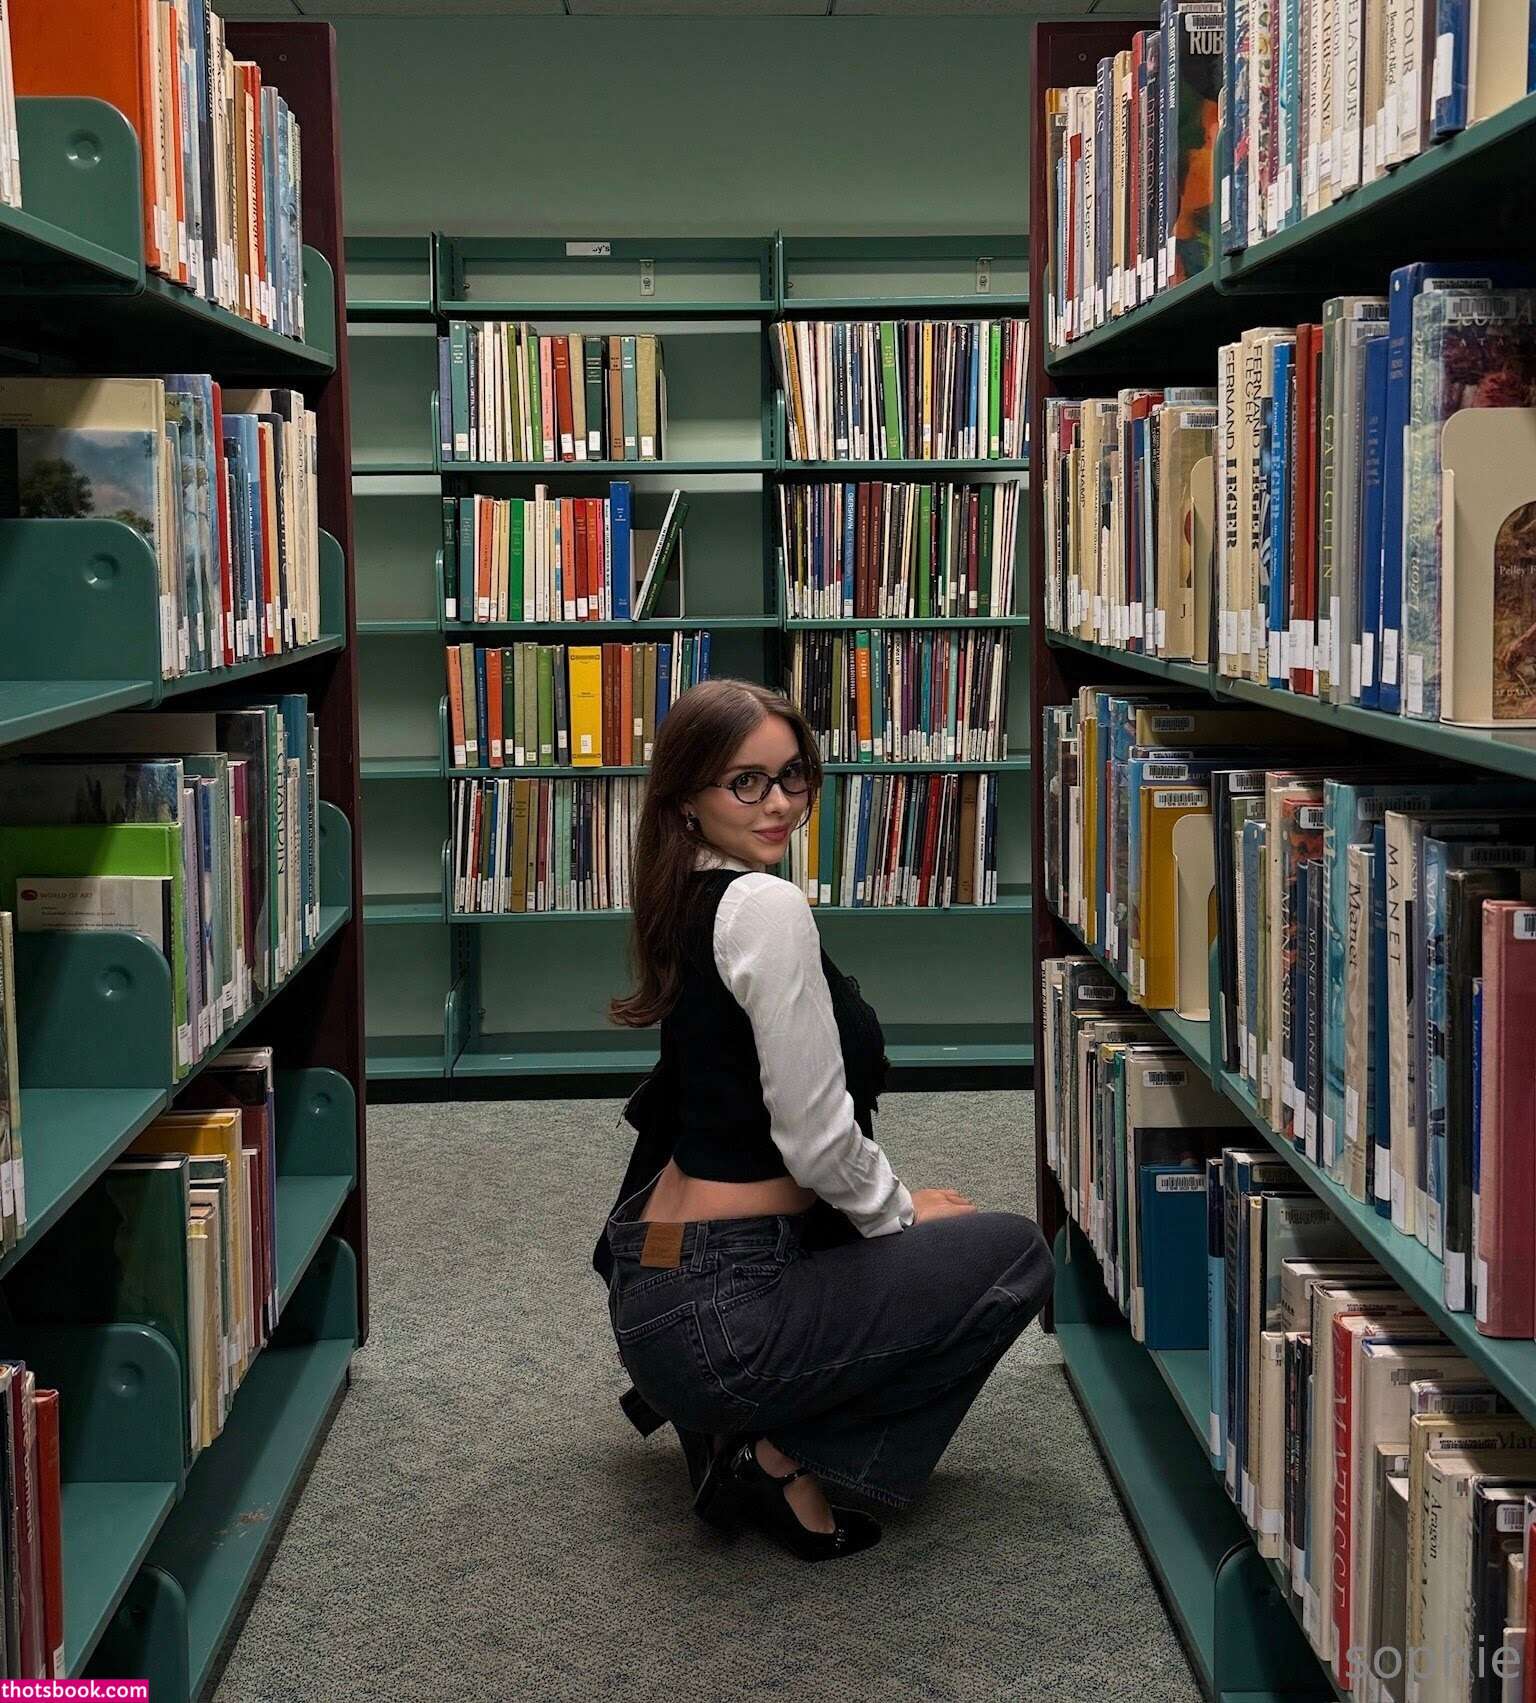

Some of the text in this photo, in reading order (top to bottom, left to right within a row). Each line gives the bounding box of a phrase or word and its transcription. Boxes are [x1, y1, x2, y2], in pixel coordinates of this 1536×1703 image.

[1346, 51, 1358, 122] TOUR
[1157, 181, 1165, 245] MOROCCO
[1158, 161, 1165, 175] IN
[1084, 193, 1093, 248] Degas
[1225, 350, 1235, 450] FERNAND
[1252, 345, 1263, 449] FERNAND
[1324, 414, 1336, 579] GAUGUIN
[277, 753, 287, 876] CHARDIN
[1387, 843, 1401, 966] MANET
[1426, 877, 1437, 971] MANET
[1281, 889, 1291, 1041] MANESSIER
[1308, 927, 1318, 999] MANET
[1429, 1493, 1443, 1559] Aragon
